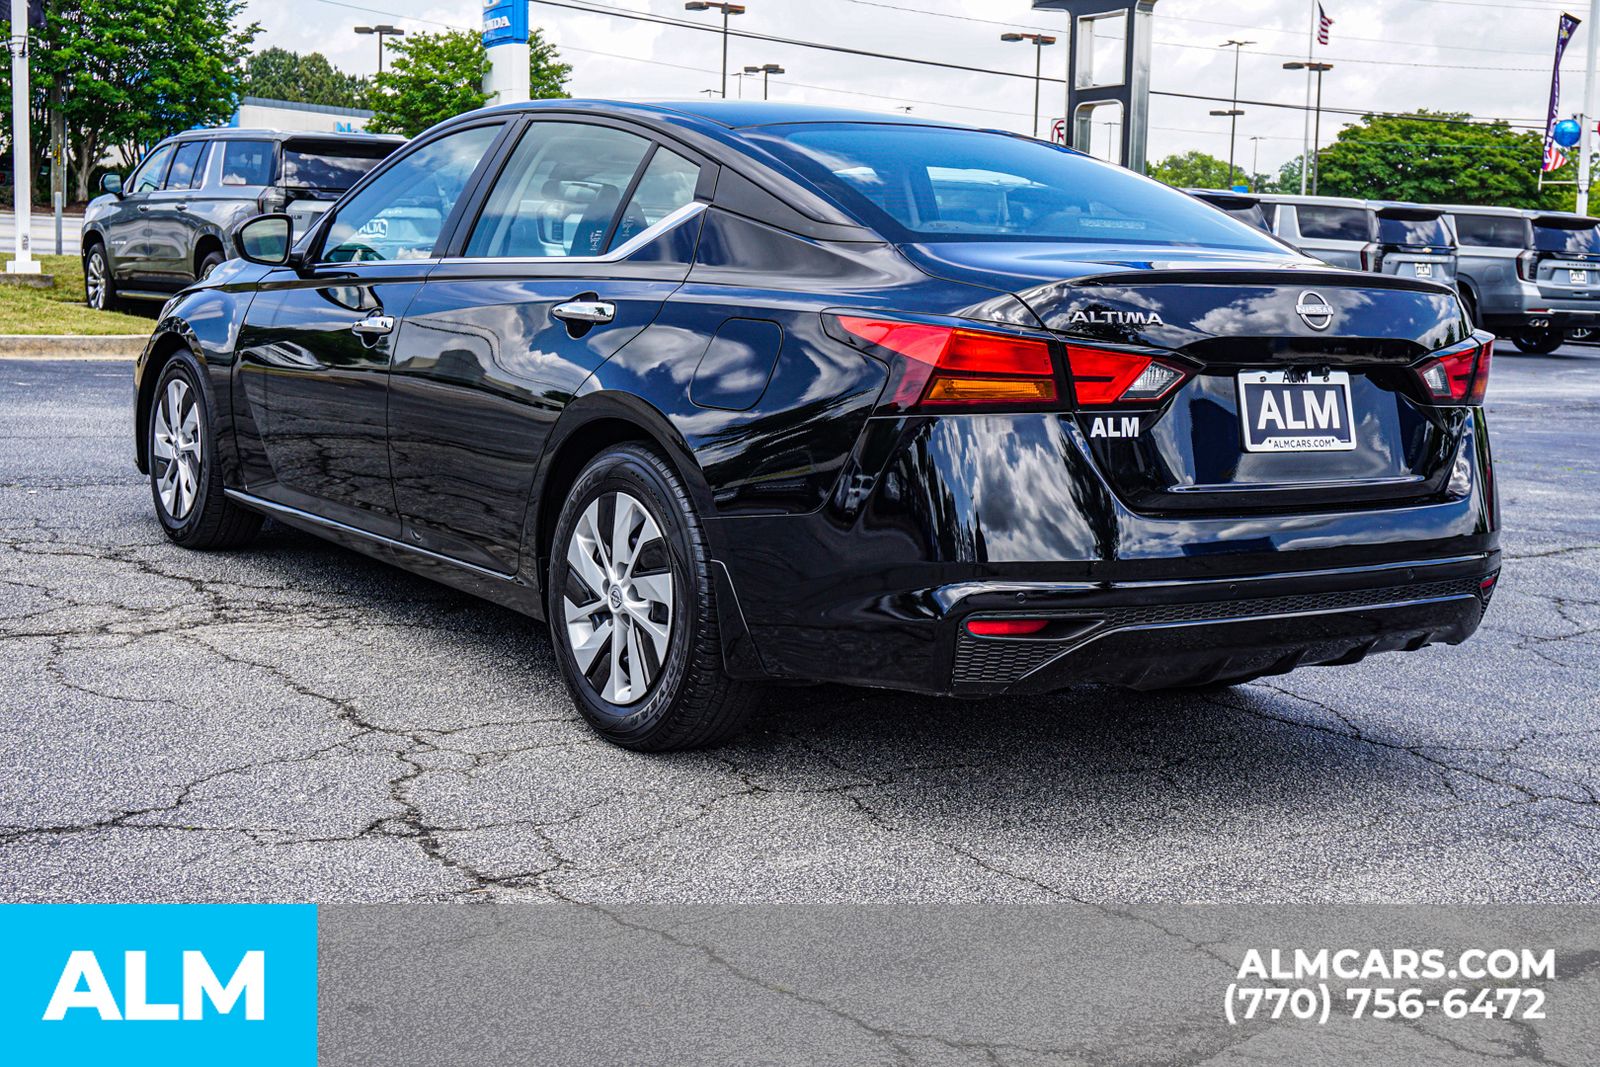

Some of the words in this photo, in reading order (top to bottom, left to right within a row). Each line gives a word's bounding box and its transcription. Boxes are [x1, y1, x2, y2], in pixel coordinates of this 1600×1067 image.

[1070, 310, 1164, 325] ALTIMA
[1282, 369, 1310, 384] ALM
[1257, 389, 1341, 430] ALM
[1090, 417, 1140, 438] ALM
[1273, 439, 1332, 449] ALMCARS.COM
